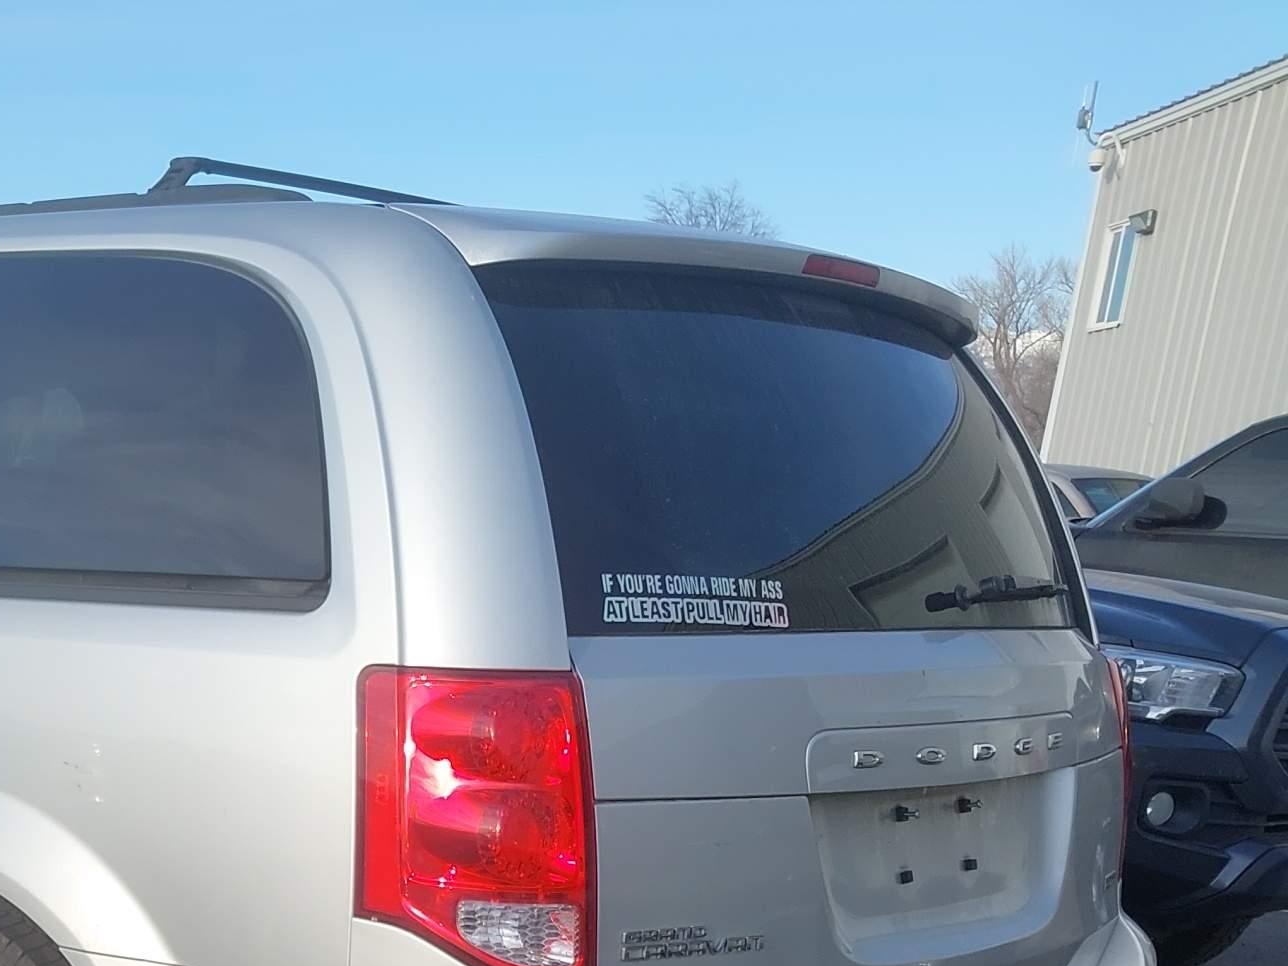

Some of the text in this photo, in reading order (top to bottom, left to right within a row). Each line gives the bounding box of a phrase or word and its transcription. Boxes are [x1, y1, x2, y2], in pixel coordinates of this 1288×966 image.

[601, 573, 784, 600] IF YOU'RE GONNA RIDE MY ASS
[605, 598, 788, 627] AT LEAST PULL MY HAIR
[853, 732, 1064, 769] DODGE
[621, 925, 708, 944] GRAND
[620, 935, 765, 962] CARAVAN
